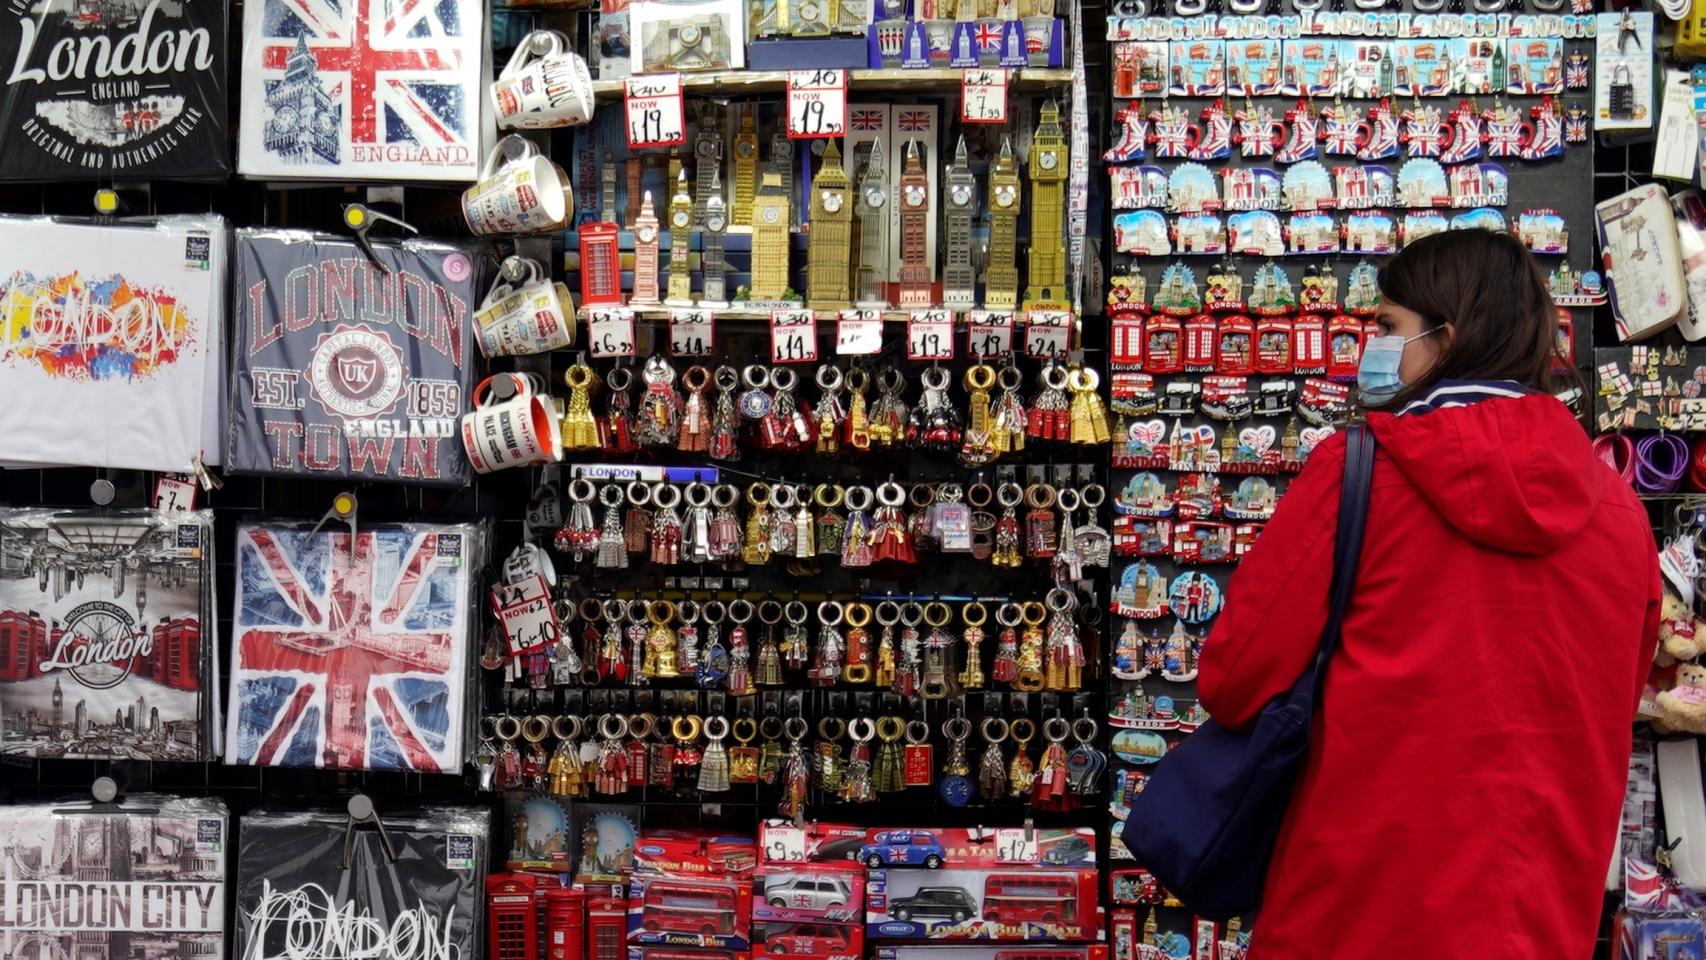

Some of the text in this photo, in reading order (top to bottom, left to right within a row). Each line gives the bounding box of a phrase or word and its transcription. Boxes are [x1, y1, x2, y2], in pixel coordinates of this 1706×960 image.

[1107, 15, 1201, 41] LONDON
[1202, 14, 1300, 40] LONDON
[1300, 9, 1398, 37] LONDON
[1398, 13, 1496, 39] LONDON
[1497, 13, 1596, 39] LONDON
[6, 0, 214, 85] London
[92, 80, 140, 99] ENGLAND
[631, 101, 657, 109] NOW
[22, 107, 203, 169] ORIGINAL AND AUTHENTIC WEAR
[352, 145, 469, 163] ENGLAND
[1112, 196, 1167, 210] LONDON
[1225, 196, 1281, 210] LONDON
[1337, 193, 1393, 209] LONDON
[1452, 192, 1508, 208] LONDON
[453, 262, 461, 273] S
[250, 258, 466, 370] LONDON
[1112, 303, 1145, 311] LONDON
[1210, 302, 1242, 310] LONDON
[1304, 303, 1338, 311] LONDON
[5, 278, 180, 363] LONDON
[343, 363, 369, 383] UK
[1111, 362, 1143, 371] LONDON
[1185, 365, 1214, 373] LONDON
[1294, 366, 1326, 375] LONDON
[252, 370, 305, 408] EST.
[407, 382, 461, 417] 1859
[343, 419, 455, 438] ENGLAND
[264, 421, 440, 479] TOWN
[1112, 456, 1169, 468] LONDON
[1169, 461, 1220, 472] LONDON
[589, 468, 638, 477] LONDON
[161, 480, 180, 490] NOW
[1125, 508, 1159, 517] LONDON
[504, 606, 529, 620] NOW
[1121, 607, 1159, 619] LONDON
[39, 623, 152, 671] London
[1125, 719, 1166, 728] LONDON
[0, 883, 216, 929] LONDON CITY
[243, 879, 460, 960] LONDON
[1045, 924, 1082, 936] TAXI
[666, 934, 726, 947] LONDON BUS
